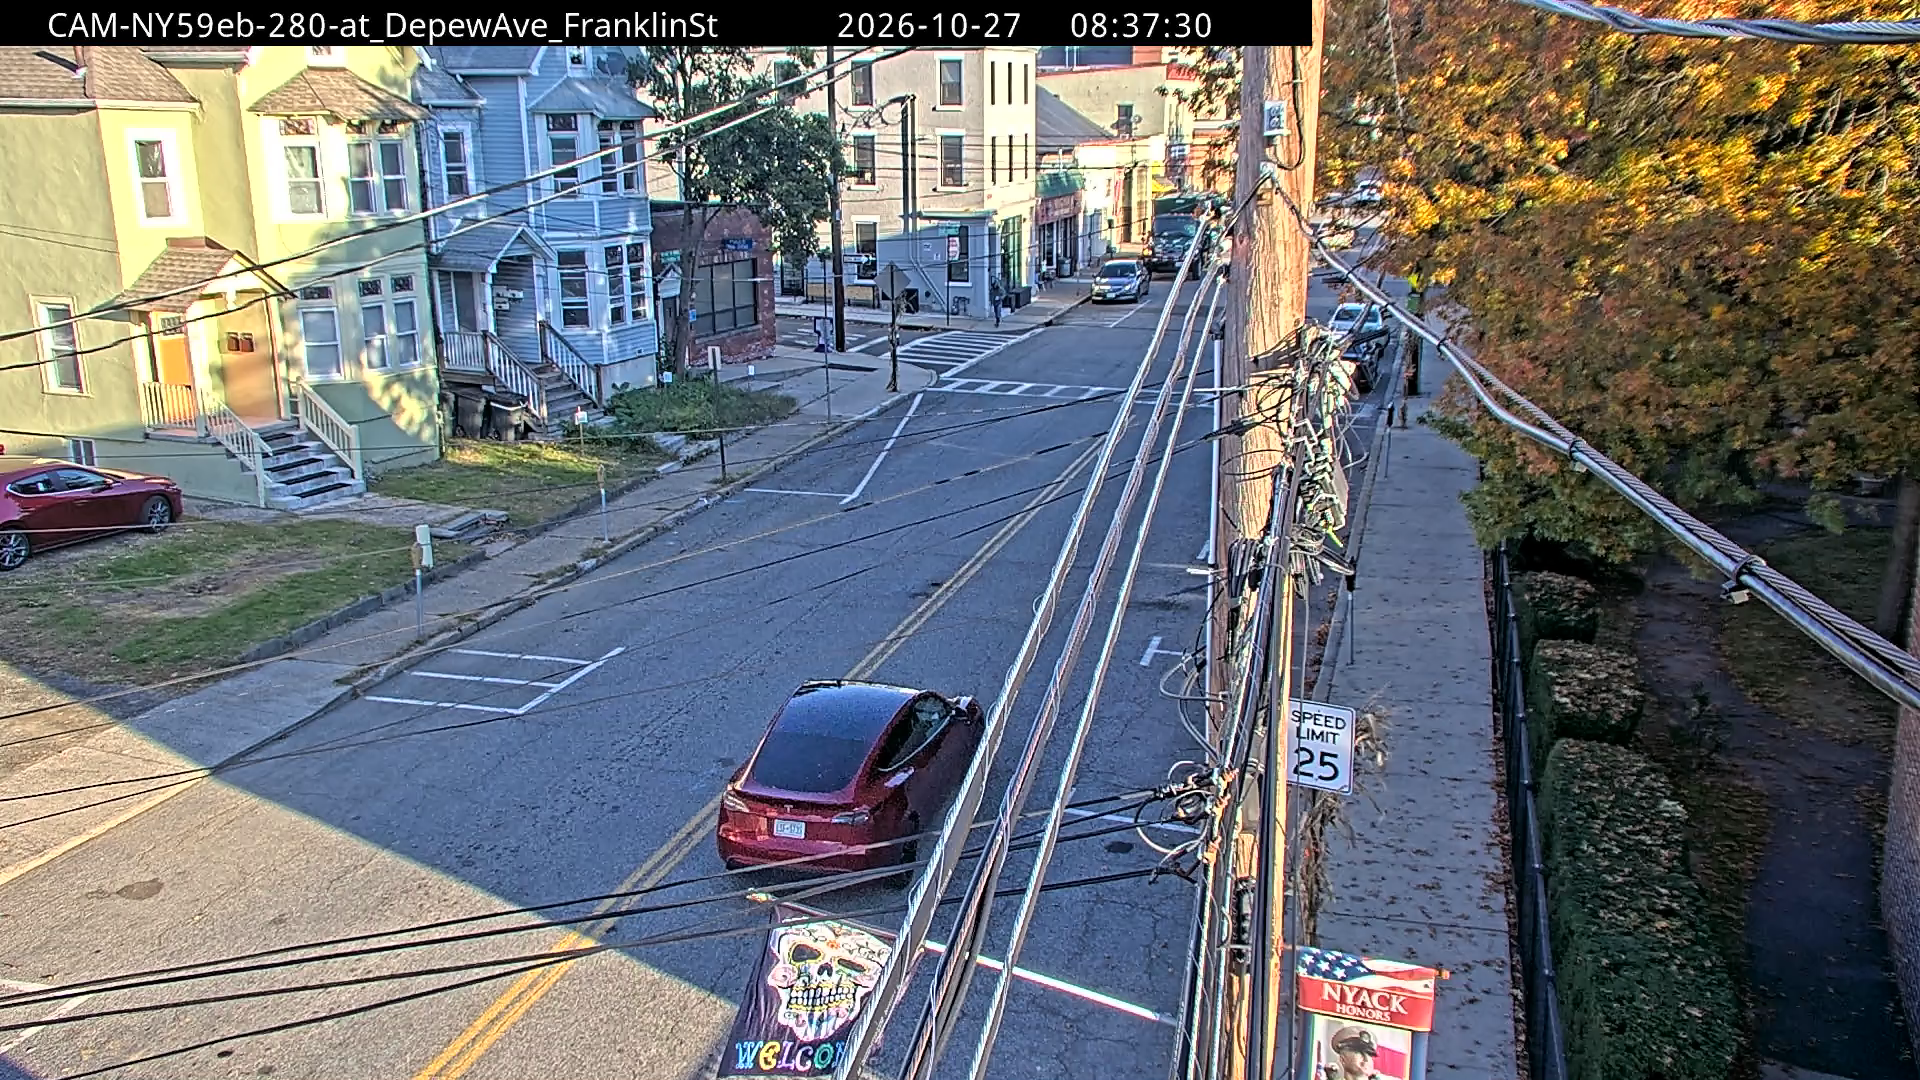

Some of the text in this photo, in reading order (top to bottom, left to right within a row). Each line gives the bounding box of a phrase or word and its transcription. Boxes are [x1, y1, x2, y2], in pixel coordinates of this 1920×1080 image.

[1291, 710, 1347, 730] SPEED
[1296, 725, 1340, 745] LIMIT
[1293, 746, 1339, 781] 25
[1321, 982, 1408, 1015] NYACK
[1336, 1002, 1391, 1021] HONORS
